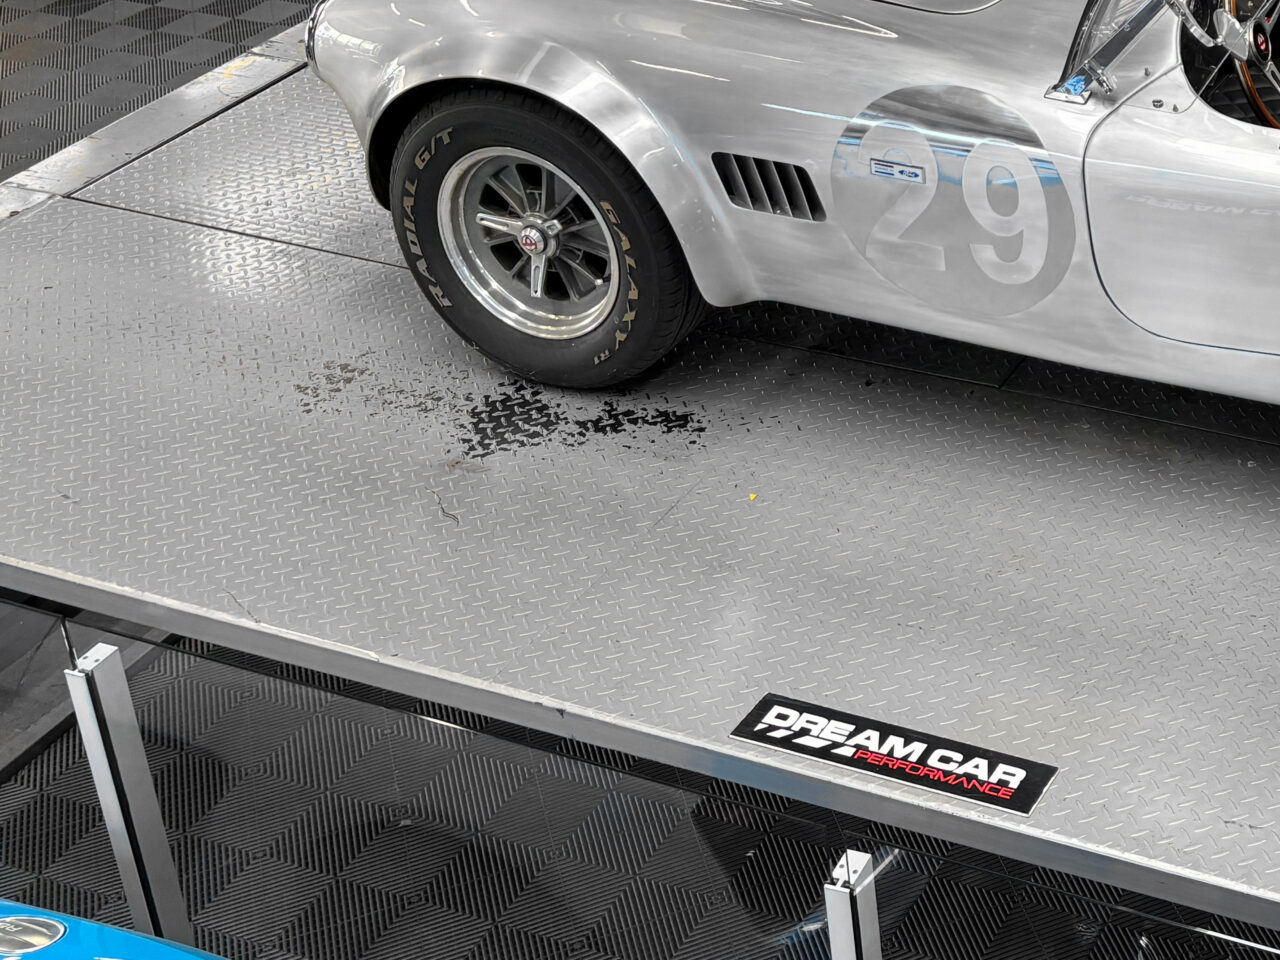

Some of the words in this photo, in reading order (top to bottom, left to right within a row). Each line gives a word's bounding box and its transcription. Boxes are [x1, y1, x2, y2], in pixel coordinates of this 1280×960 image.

[414, 126, 453, 171] G/T
[858, 119, 1049, 285] 29
[403, 178, 453, 308] RADIAL
[600, 201, 640, 351] GALAXY
[760, 704, 928, 763] DREAM
[926, 748, 1028, 789] CAR
[853, 749, 1016, 800] PERFORMANCE
